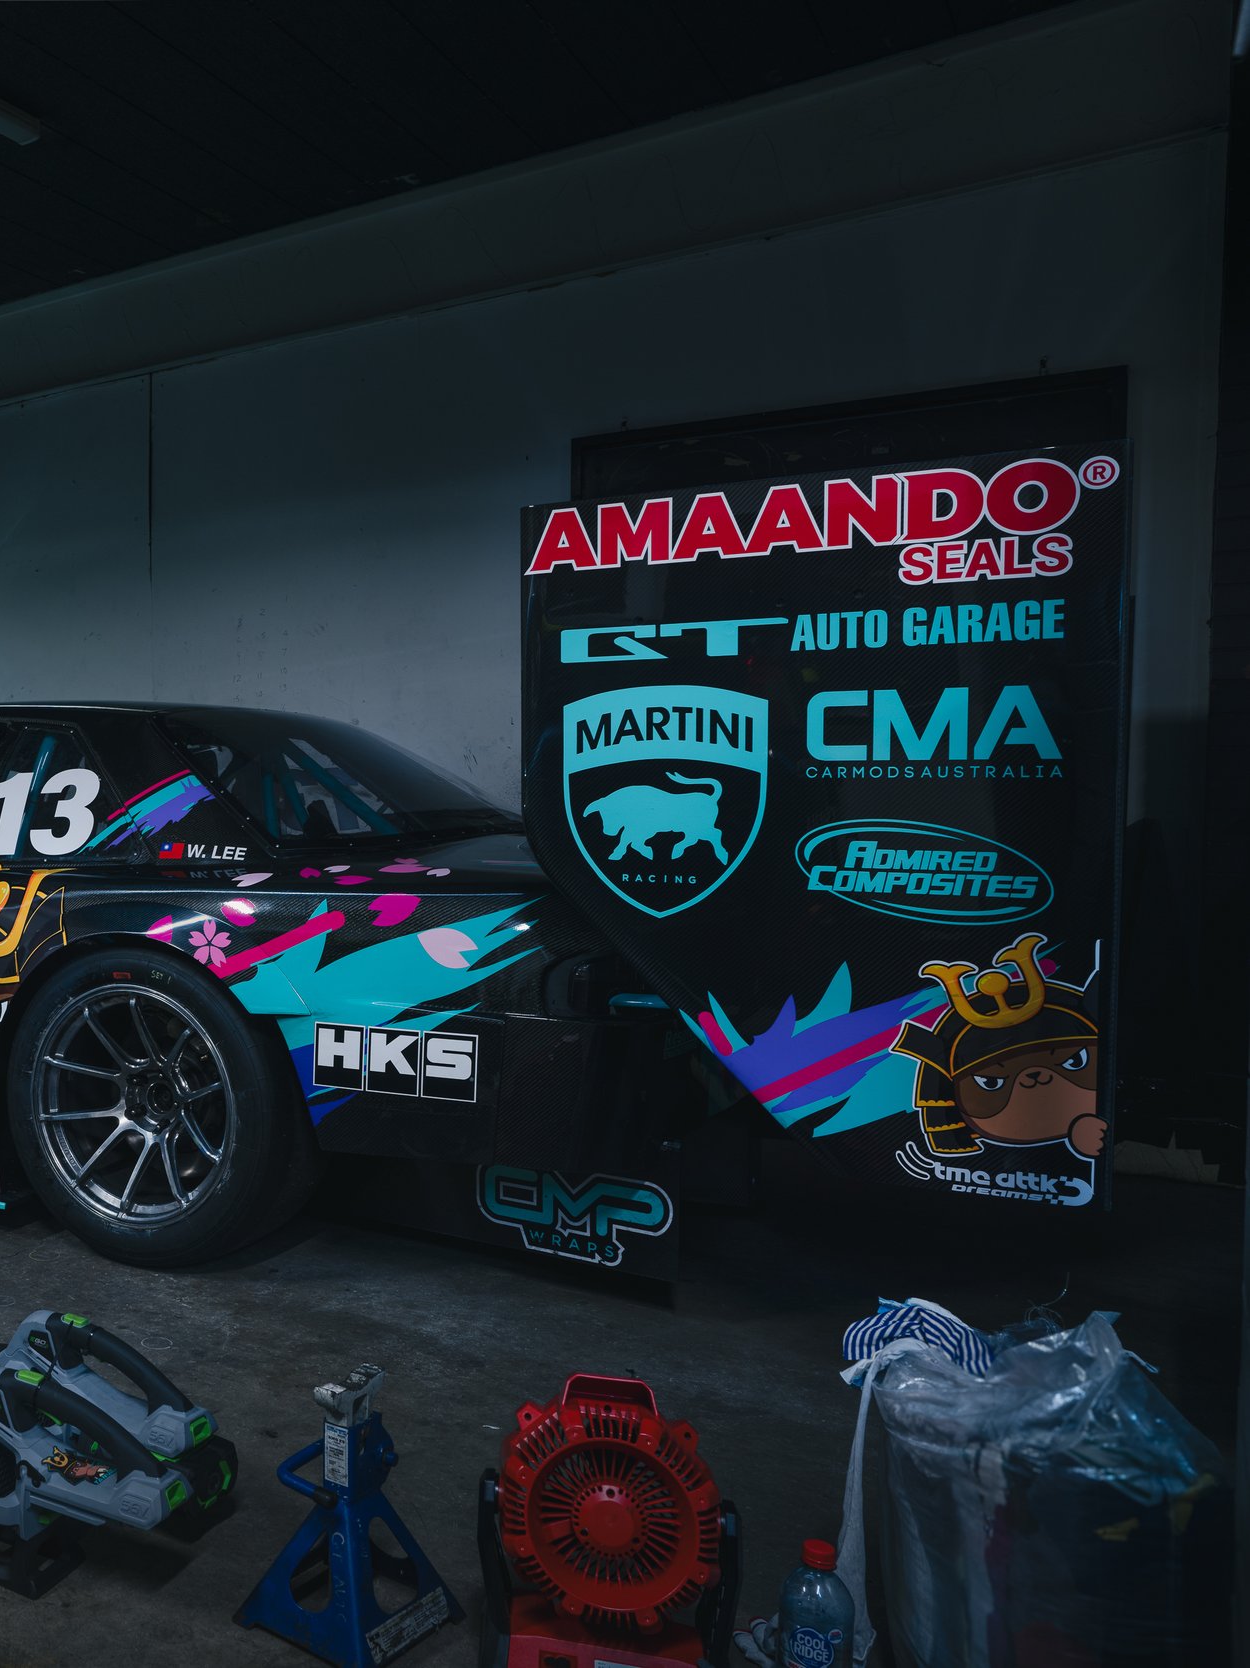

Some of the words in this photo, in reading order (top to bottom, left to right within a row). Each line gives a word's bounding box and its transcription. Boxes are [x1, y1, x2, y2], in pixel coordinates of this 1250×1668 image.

[525, 458, 1080, 575] AMAANDO
[898, 533, 1073, 585] SEALS
[560, 617, 789, 663] GT
[790, 608, 888, 652] AUTO
[901, 599, 1065, 645] GARAGE
[576, 706, 754, 755] MARTINI
[806, 685, 1063, 761] CMA
[805, 765, 1064, 780] CARMODSAUSTRALIA
[187, 843, 206, 859] W.
[211, 845, 248, 861] LEE
[844, 840, 999, 872] ADMIRED
[622, 873, 697, 885] RACING
[807, 865, 1039, 899] COMPOSITES
[318, 1027, 474, 1081] HKS
[484, 1164, 666, 1237] CMP
[529, 1229, 615, 1258] WRAPS
[793, 1641, 830, 1663] RIDGE
[796, 1633, 828, 1652] COOL
